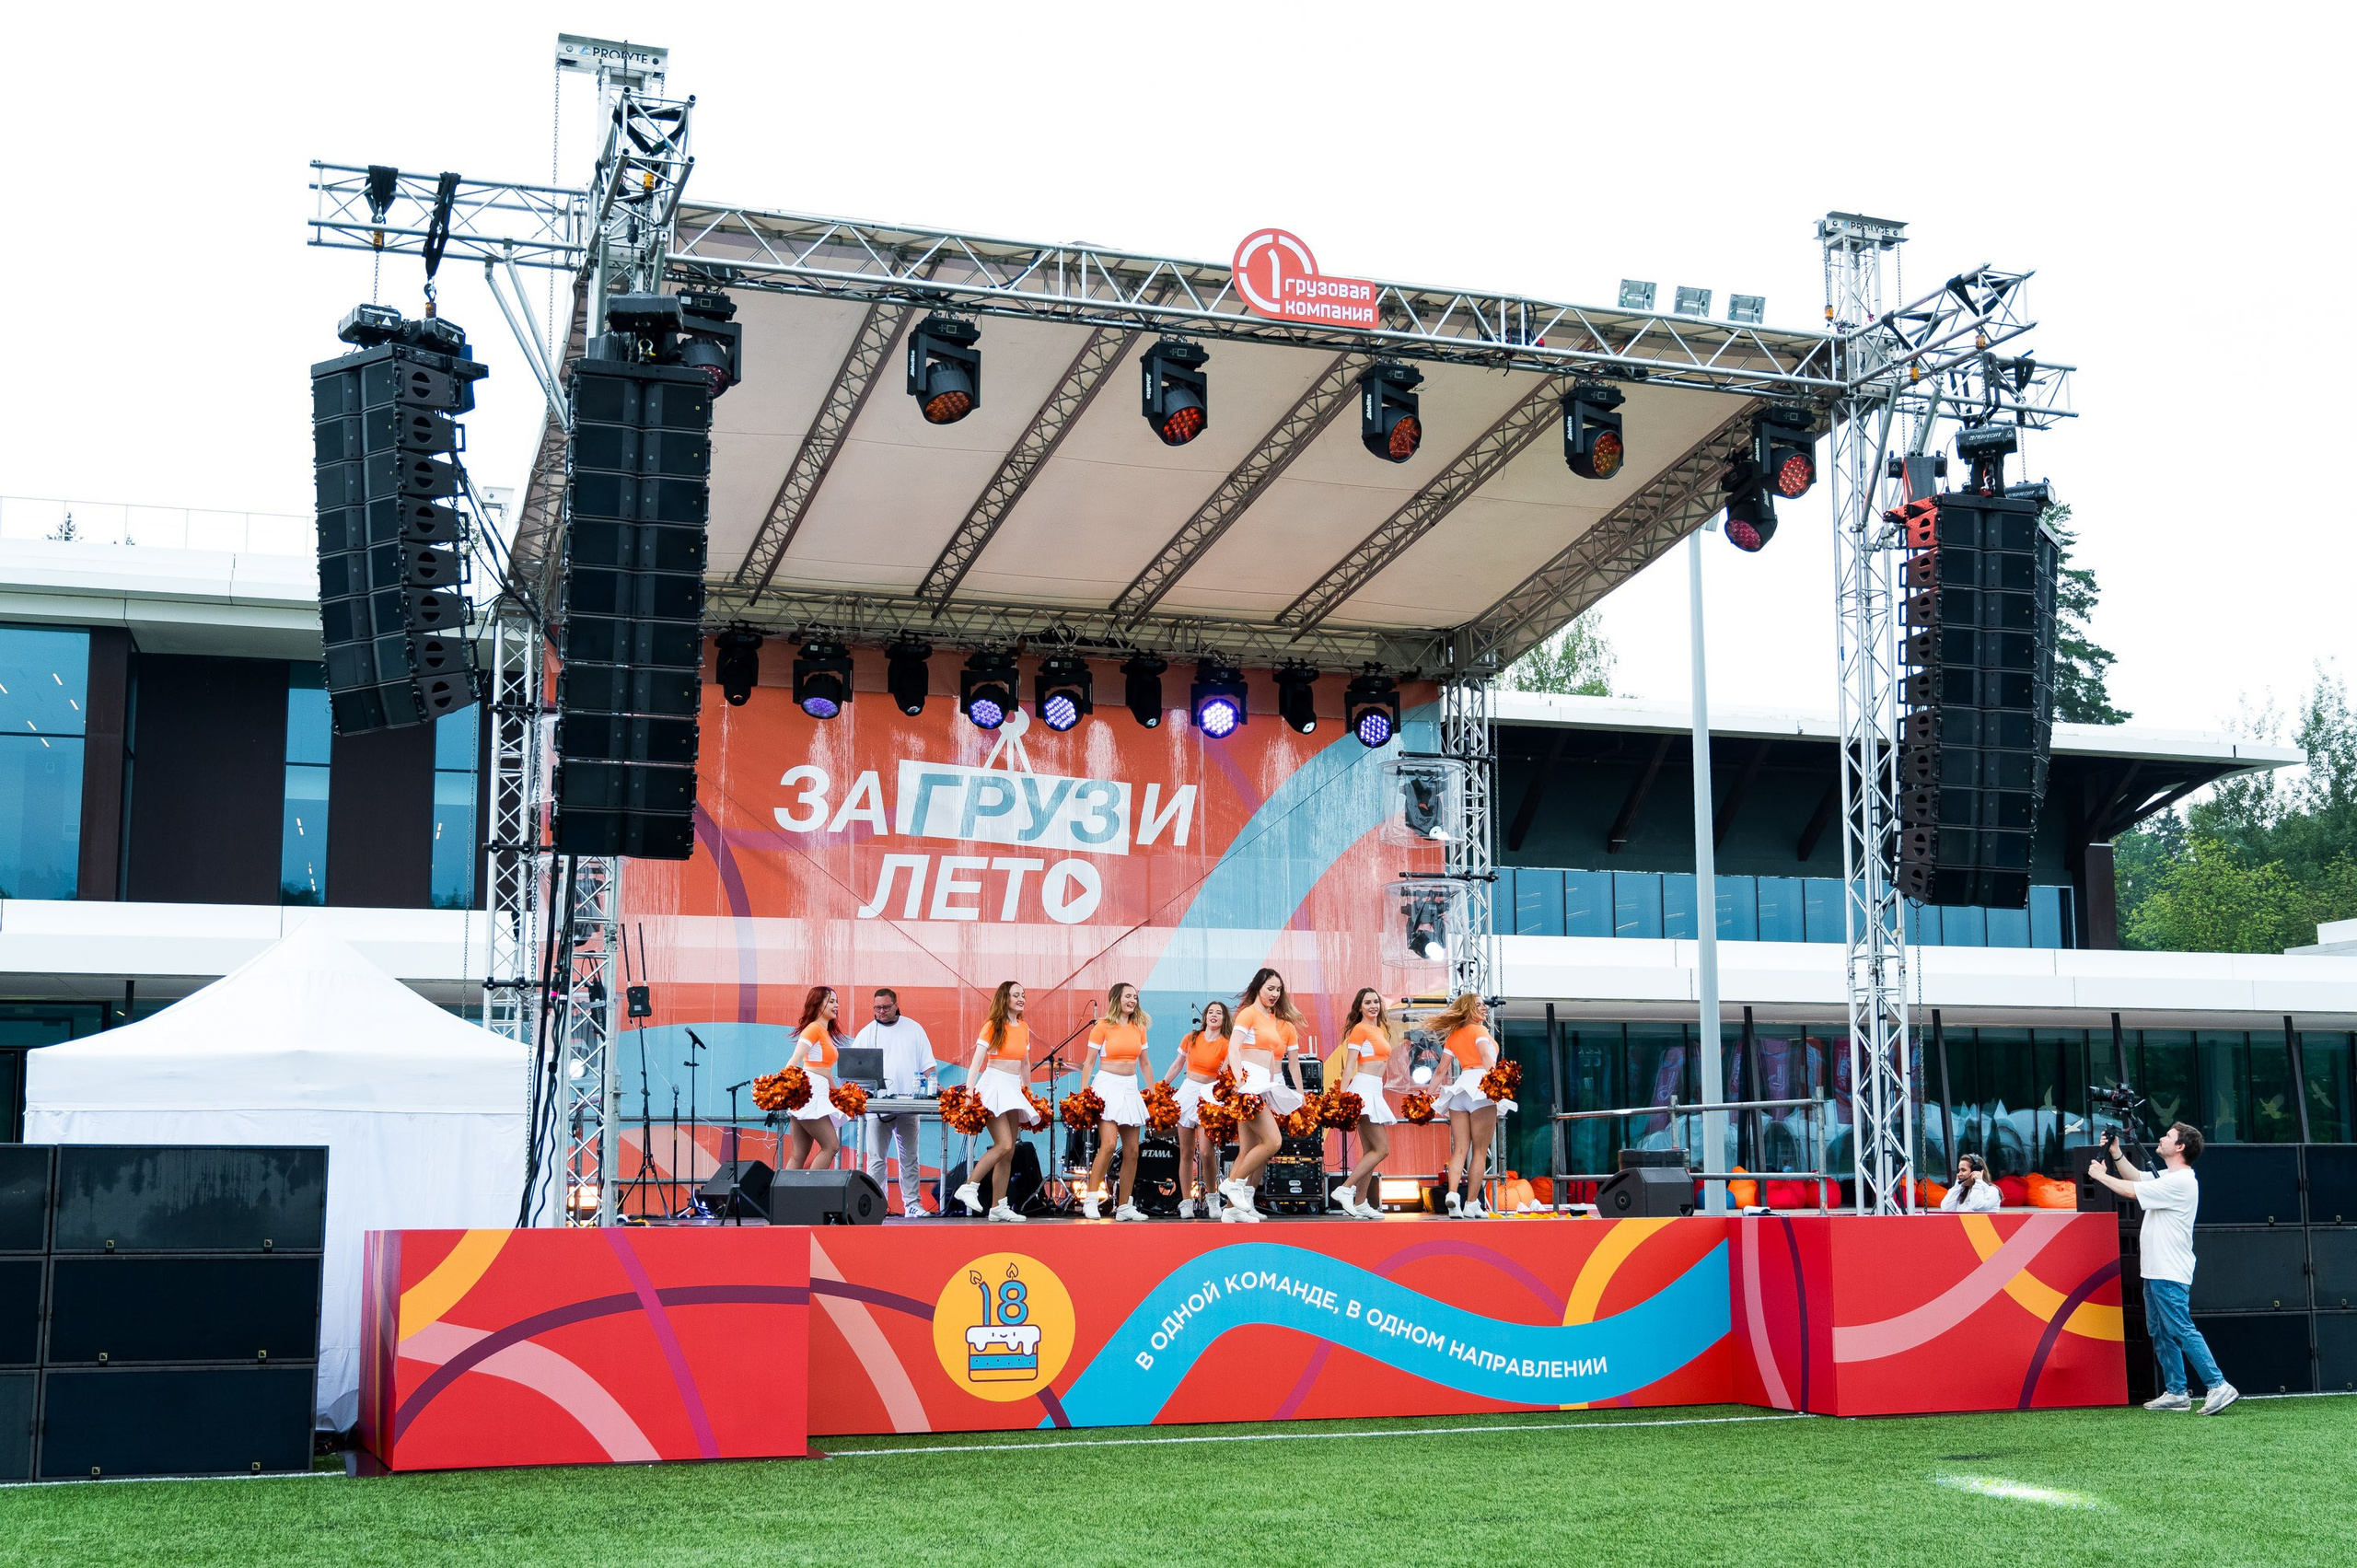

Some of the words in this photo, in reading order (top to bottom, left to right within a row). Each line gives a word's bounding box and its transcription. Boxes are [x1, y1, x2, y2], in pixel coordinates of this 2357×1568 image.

[1284, 300, 1374, 322] компания
[773, 764, 1198, 847] ЗАГРУЗИ
[857, 854, 1102, 924] ЛЕТО
[979, 1280, 1029, 1326] 18
[1135, 1351, 1155, 1371] В
[1151, 1280, 1221, 1350] ОДНОЙ
[1224, 1271, 1340, 1314] КОМАНДЕ,
[1345, 1299, 1362, 1318] В
[1366, 1308, 1446, 1353] ОДНОМ
[1448, 1340, 1608, 1378] НАПРАВЛЕНИИ
